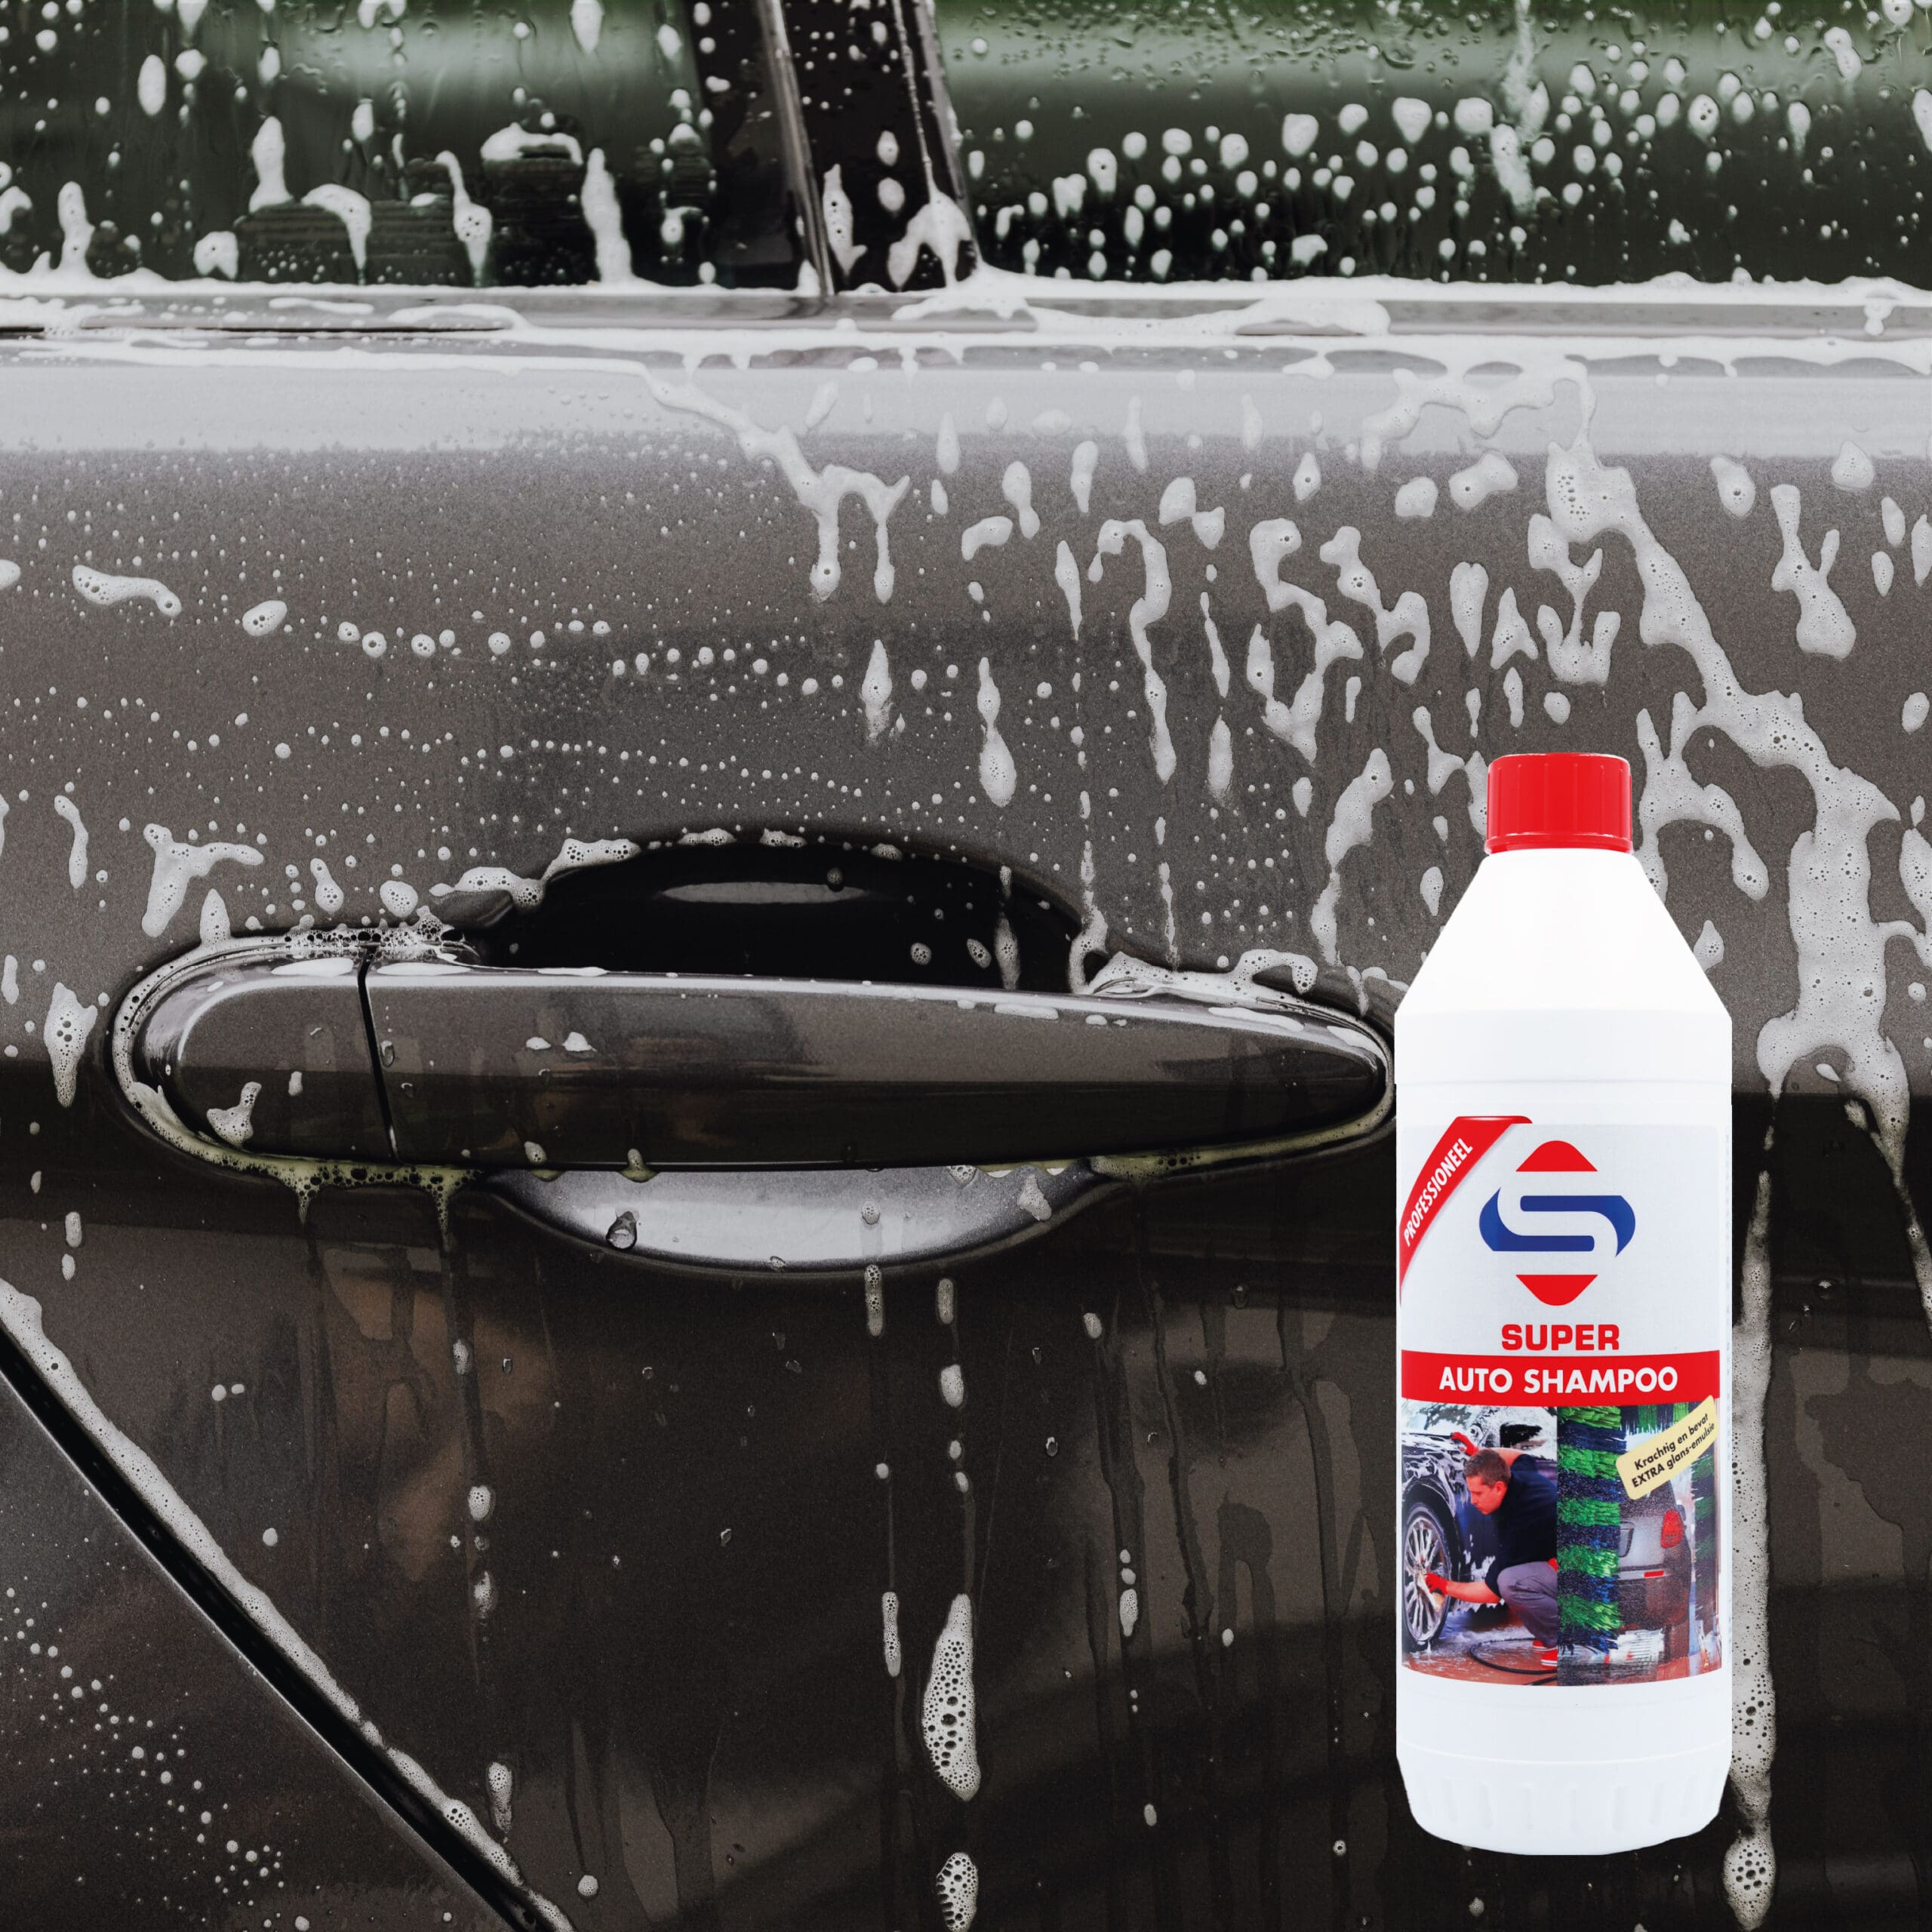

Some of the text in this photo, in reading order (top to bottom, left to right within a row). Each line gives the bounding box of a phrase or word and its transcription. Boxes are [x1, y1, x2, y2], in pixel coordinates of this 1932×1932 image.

[1403, 1138, 1473, 1247] PROFESSIONEEL
[1502, 1324, 1620, 1351] SUPER
[1438, 1367, 1678, 1393] AUTO SHAMPOO
[1632, 1422, 1715, 1487] EXTRA glans-emulsie
[1634, 1413, 1709, 1470] Krachtig en bevat
